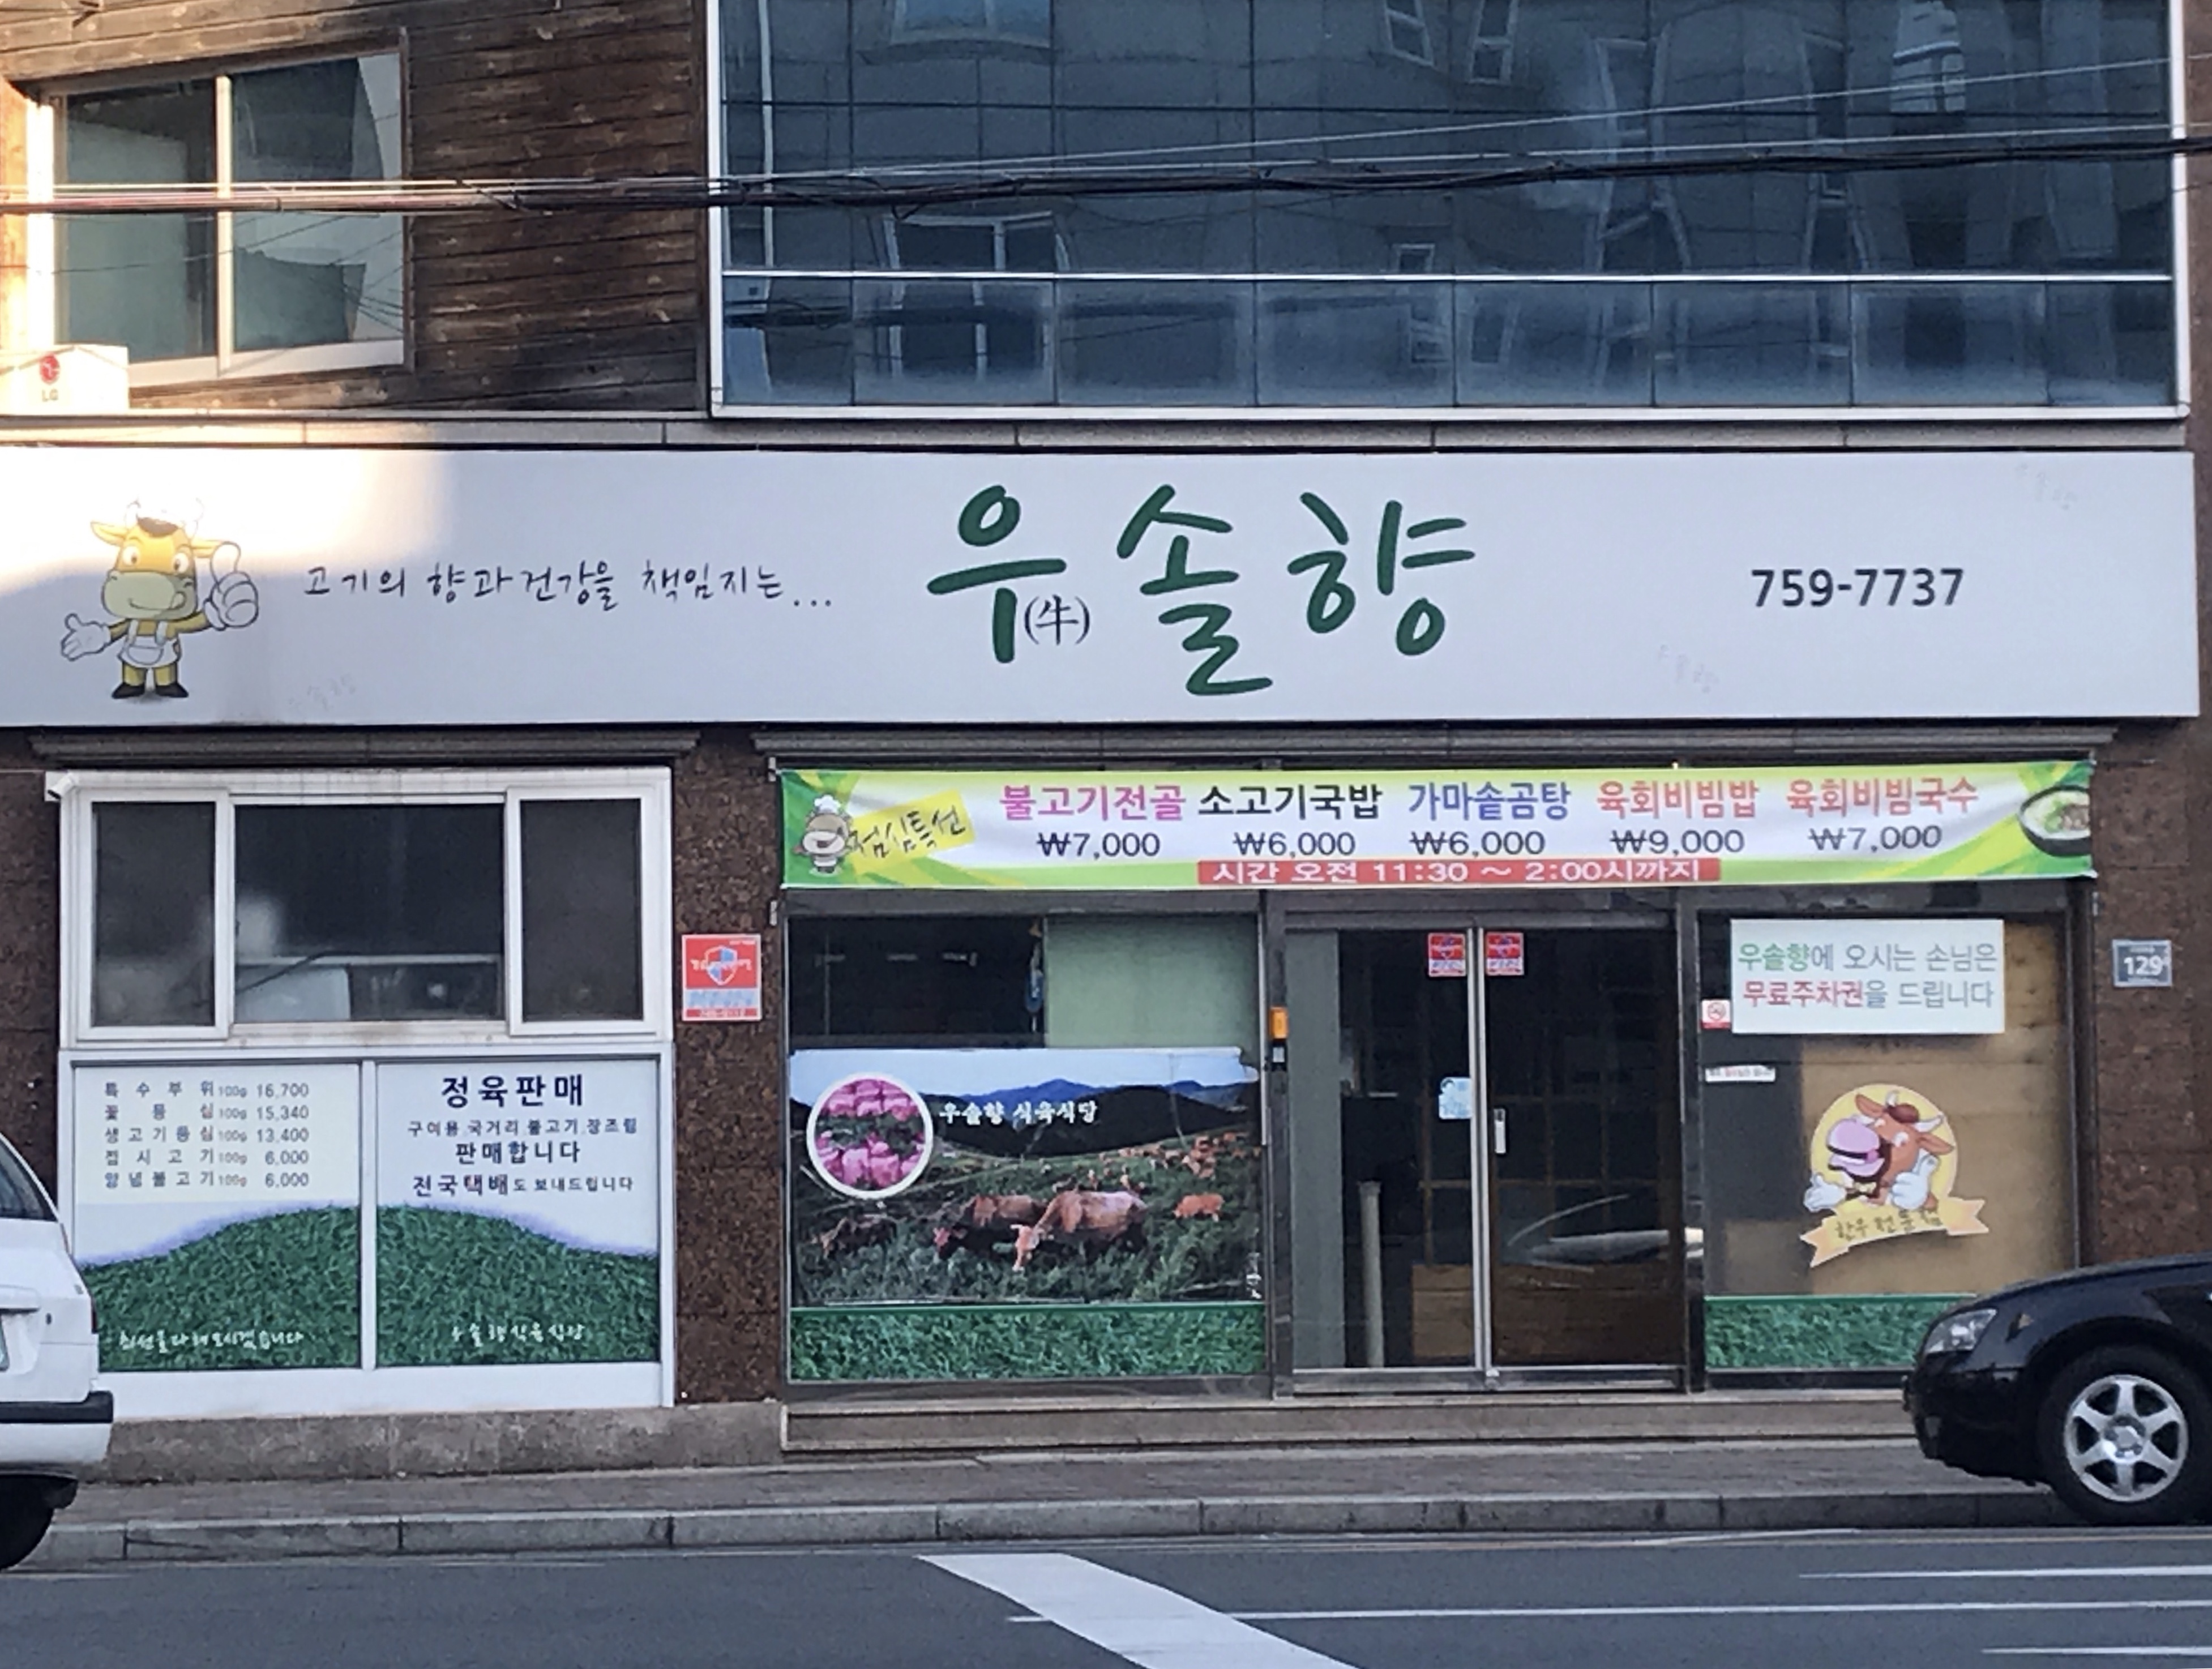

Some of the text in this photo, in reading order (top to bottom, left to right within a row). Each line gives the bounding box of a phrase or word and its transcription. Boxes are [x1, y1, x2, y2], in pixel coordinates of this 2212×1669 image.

[41, 388, 59, 402] LG
[304, 566, 406, 597] 고기의
[1751, 568, 1965, 607] 759-7737
[999, 777, 1979, 821] 불고기전골 소고기국밥 가마솥곰탕 육회비빔밥 육회비빔국수
[1213, 862, 1280, 885] 시간
[1290, 862, 1358, 884] 오전
[1372, 862, 1468, 883] 11:30
[1525, 859, 1699, 882] 2:00시까지
[1738, 943, 1998, 973] 우솔향에 오시는 손님은
[2124, 955, 2163, 976] 129
[1743, 979, 1993, 1008] 무료주차권을 드립니다
[441, 1074, 584, 1109] 정육판매
[455, 1140, 581, 1165] 판매합니다
